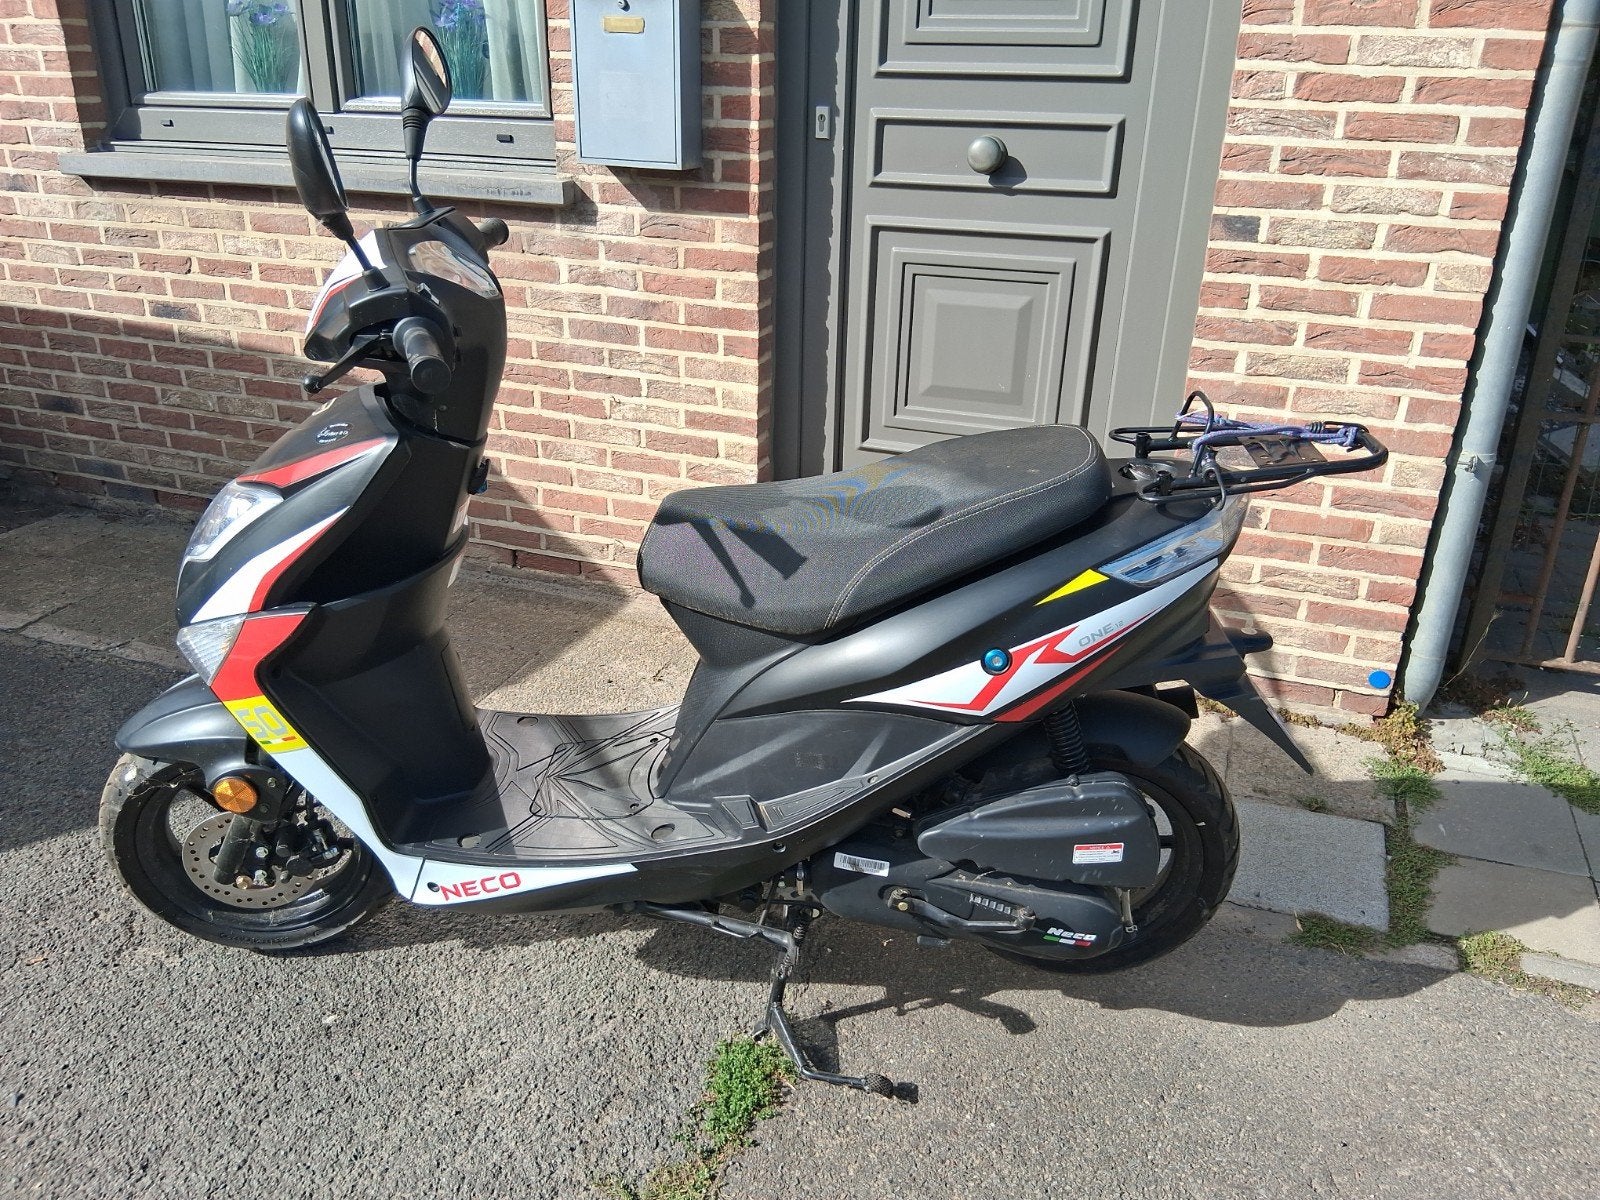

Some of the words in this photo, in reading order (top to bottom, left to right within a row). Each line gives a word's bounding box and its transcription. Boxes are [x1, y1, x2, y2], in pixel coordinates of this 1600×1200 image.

[1078, 623, 1113, 647] ONE
[235, 705, 288, 738] 50
[440, 872, 521, 901] NECO
